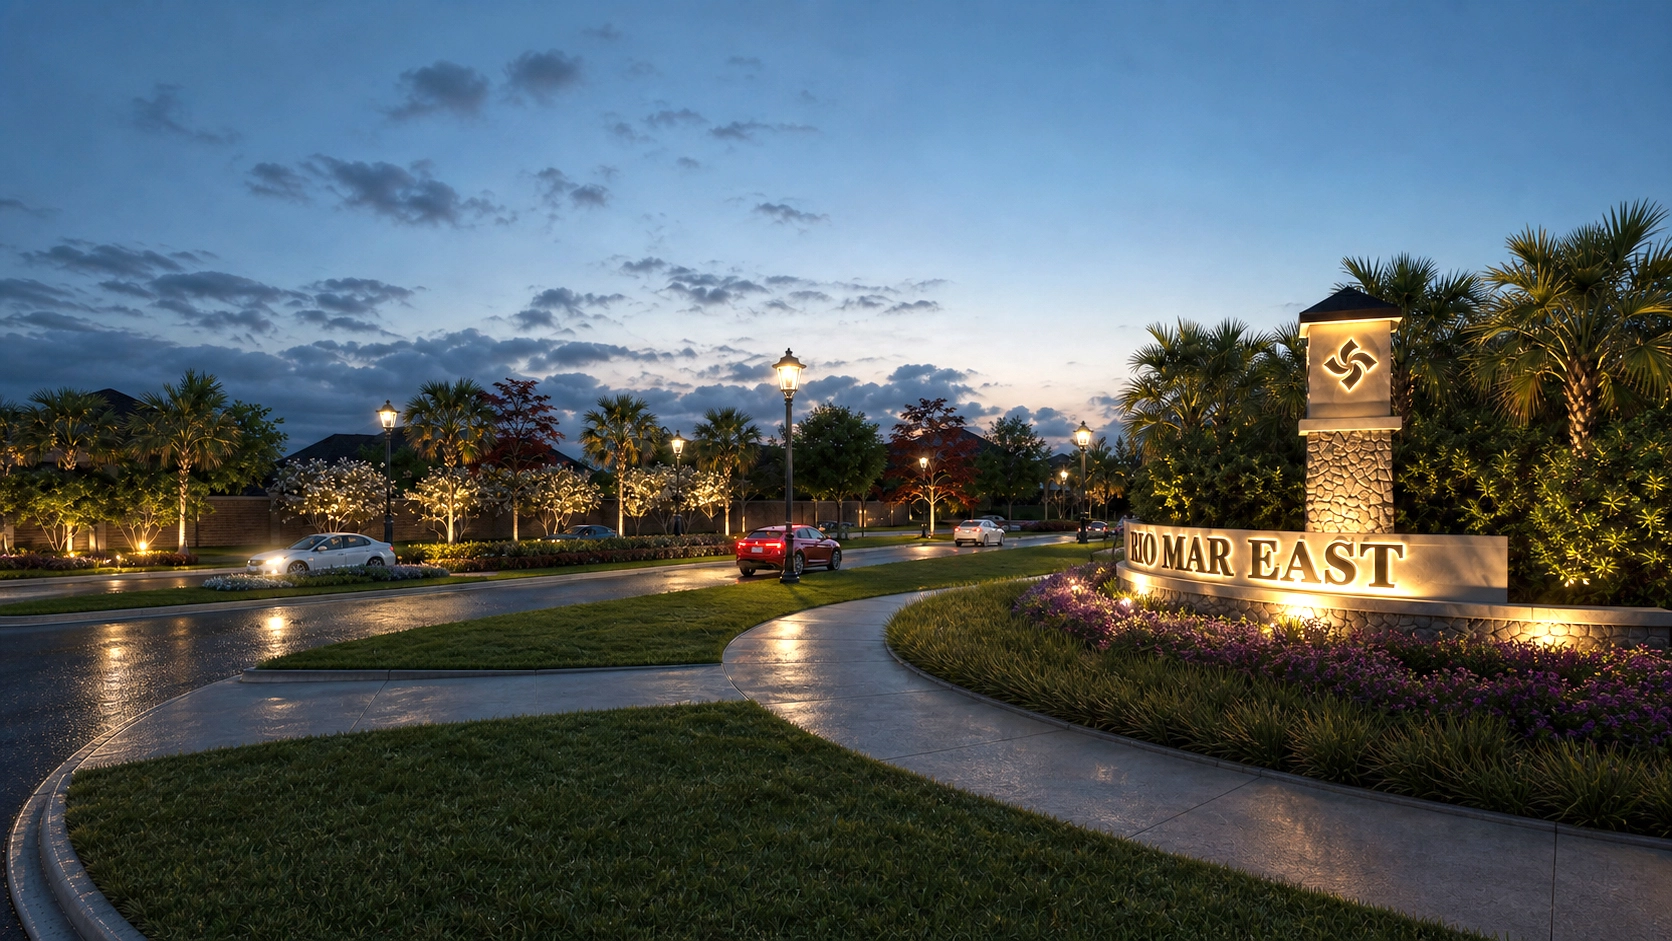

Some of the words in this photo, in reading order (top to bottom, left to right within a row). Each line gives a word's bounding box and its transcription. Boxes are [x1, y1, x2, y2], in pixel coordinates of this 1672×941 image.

[1130, 531, 1157, 566] RIO
[1162, 535, 1234, 576] MAR
[1248, 539, 1403, 588] EAST
